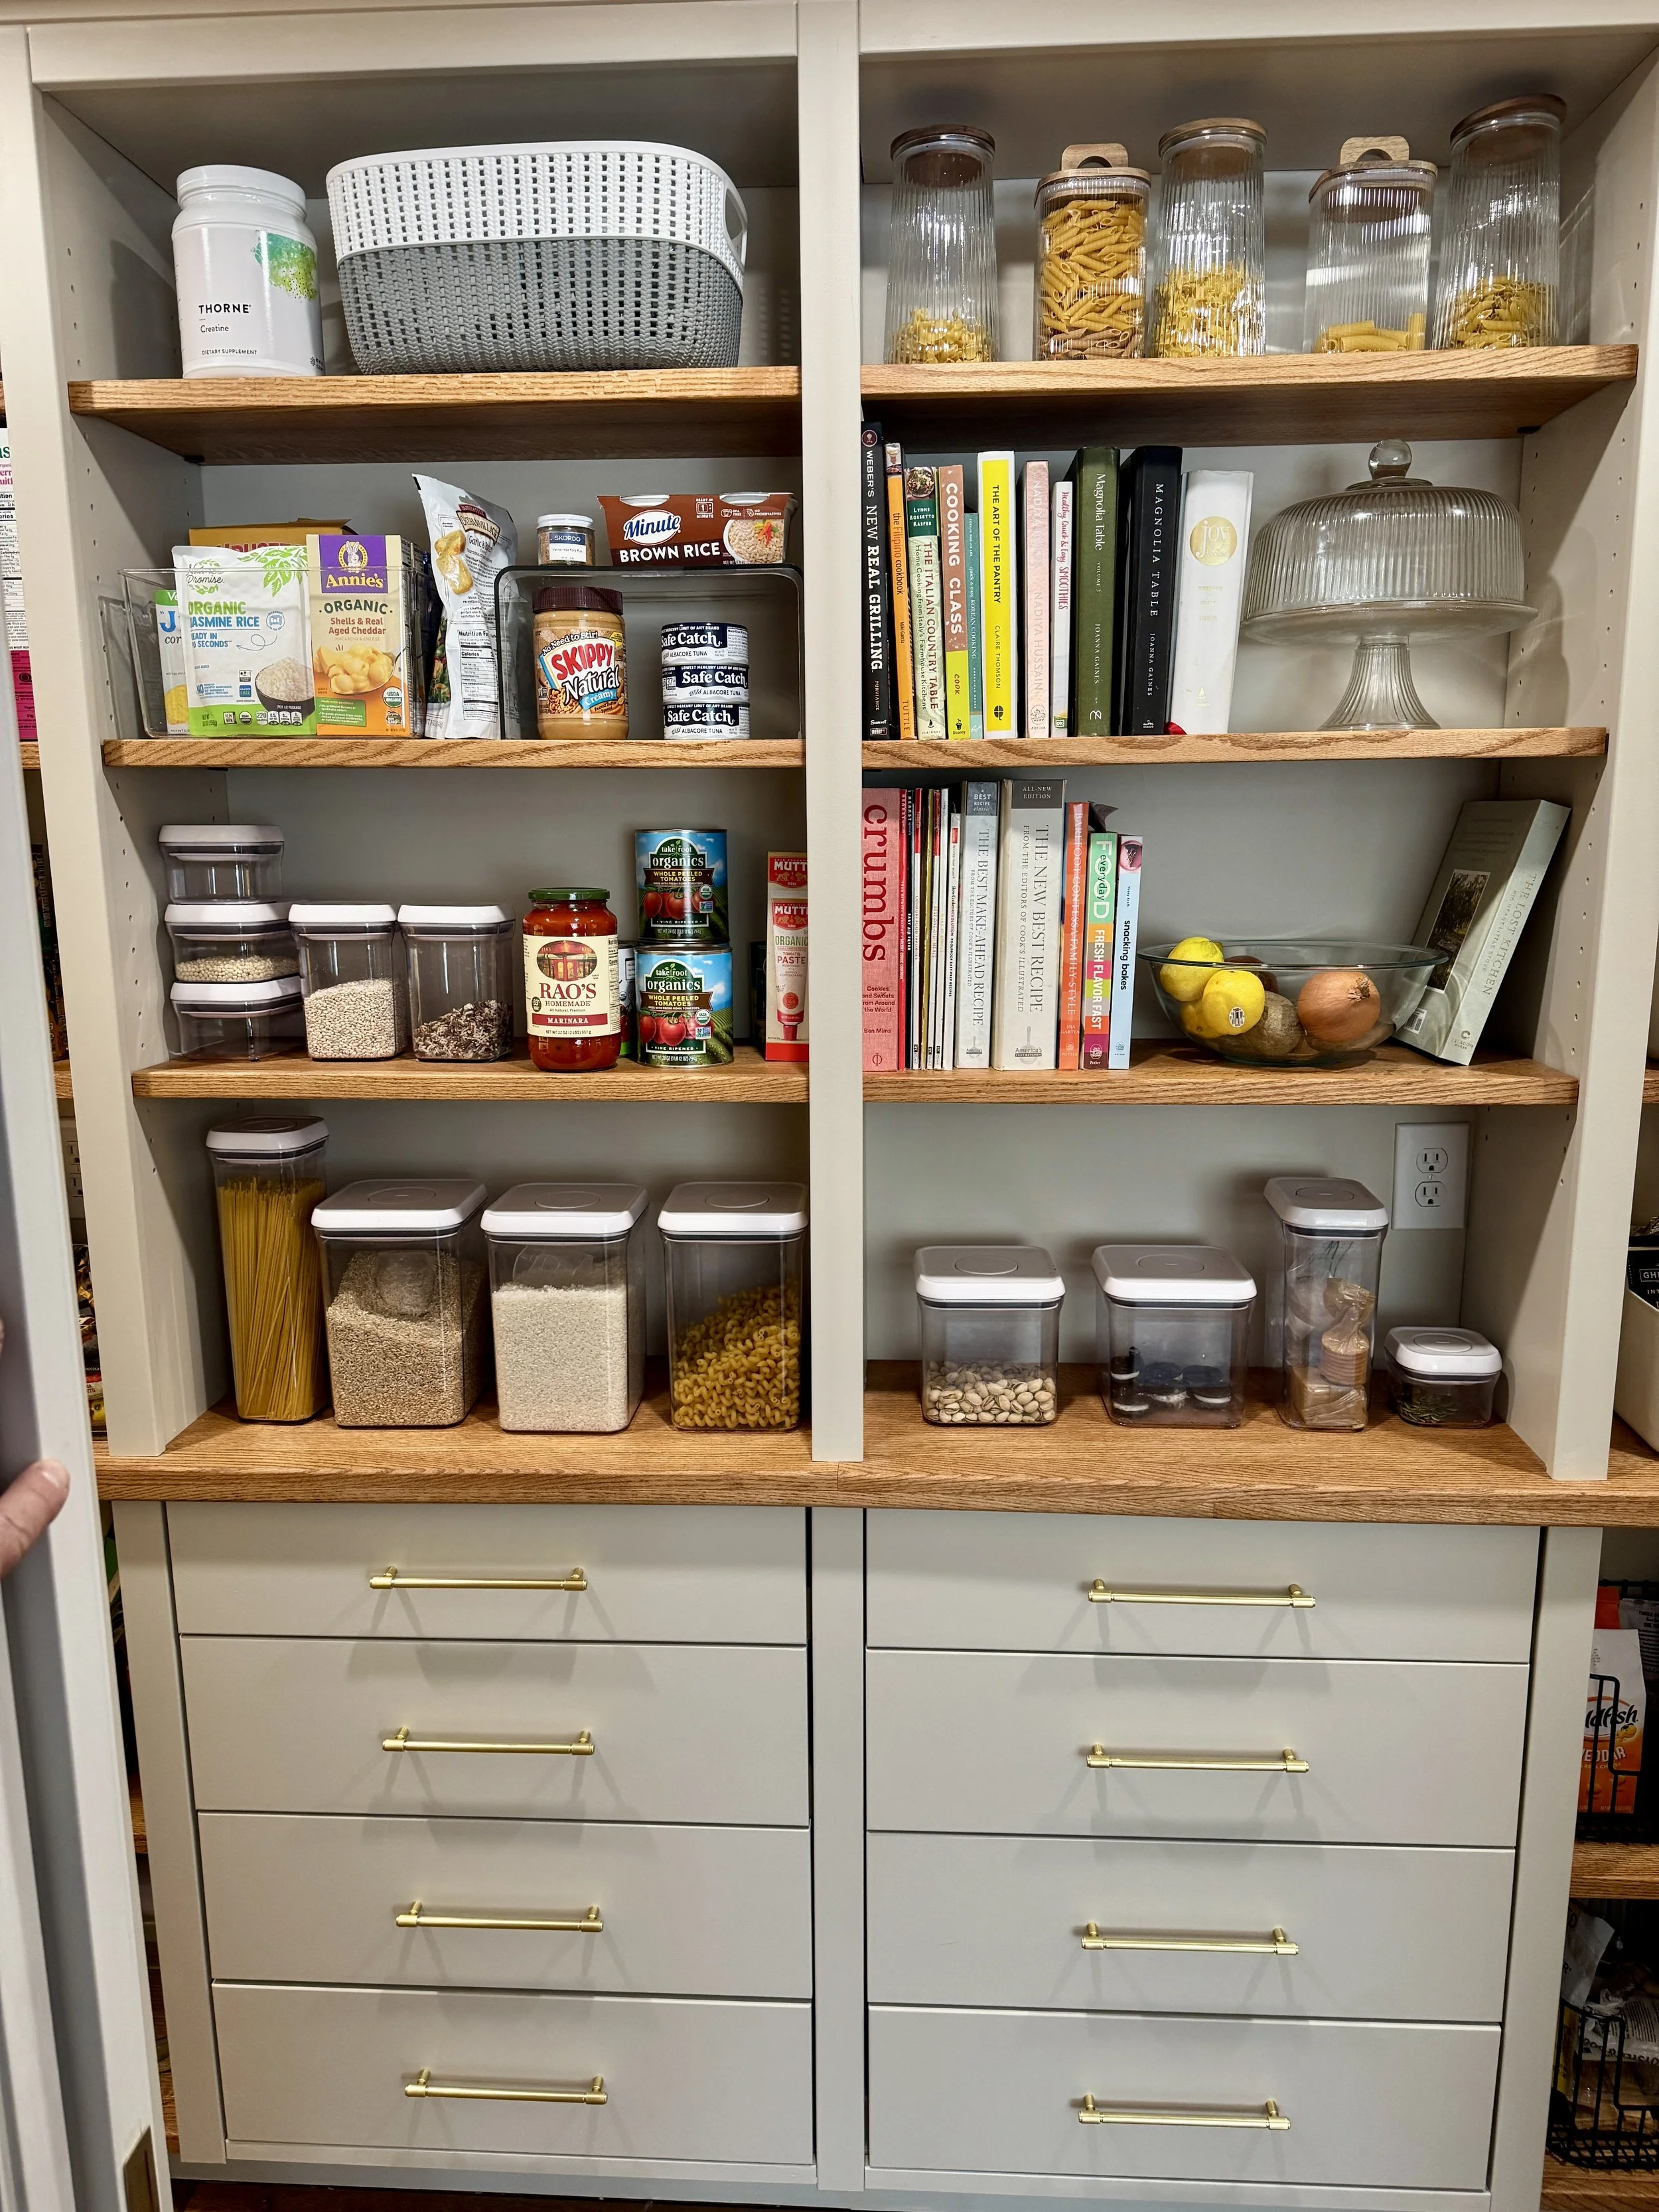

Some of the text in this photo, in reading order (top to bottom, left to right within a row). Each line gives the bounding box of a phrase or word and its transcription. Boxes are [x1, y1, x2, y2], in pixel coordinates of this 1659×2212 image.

[198, 303, 250, 315] THORNE
[200, 324, 229, 333] Creatine
[1093, 473, 1106, 551] Magnolia Table
[624, 514, 681, 540] Minute
[993, 528, 1000, 542] OF
[1195, 520, 1230, 558] joy
[619, 542, 721, 563] BROWN RICE
[892, 526, 903, 557] Filipino
[1150, 483, 1164, 616] MAGNOLIA TABLE
[866, 450, 883, 670] WEBER'S NEW REAL GRILLING
[946, 482, 963, 634] COOKING CLASS
[1056, 549, 1068, 563] Easy
[325, 573, 384, 588] Annie's
[895, 559, 906, 595] cookbook
[1058, 566, 1069, 610] SMOOTHIES
[188, 601, 246, 615] ORGANIC
[324, 599, 388, 615] ORGANIC
[236, 617, 259, 627] RICE
[328, 627, 350, 635] Aged
[924, 542, 938, 709] THE ITALIAN COUNTRY TABLE
[542, 646, 551, 656] No
[550, 635, 571, 648] Need
[581, 631, 598, 640] Stir!
[662, 633, 676, 647] Safe
[678, 631, 721, 647] Catch
[1034, 592, 1043, 691] NADIYA HUSSAIN
[551, 643, 613, 680] SKIPPY
[562, 664, 620, 705] Natural
[682, 671, 713, 684] Safe
[714, 670, 748, 688] Catch
[585, 690, 614, 705] Creamy
[667, 709, 735, 725] Safe Catch
[652, 855, 704, 869] organics
[774, 861, 808, 871] MUTT
[863, 804, 895, 962] crumbs
[1093, 840, 1112, 919] FOOD
[1097, 855, 1108, 901] everyday
[1520, 873, 1537, 899] THE
[973, 828, 989, 1025] THE BEST MAKE-AHEAD RECIPE
[1020, 911, 1027, 922] OF
[1030, 825, 1049, 1012] THE NEW BEST RECIPE
[1067, 813, 1083, 1015] BAREFOOT CONTESSA FAMILY STYLE
[1508, 903, 1525, 935] LOST
[775, 935, 808, 946] ORGANIC
[1119, 920, 1131, 990] snacking bakes
[1482, 937, 1511, 995] KITCHEN
[539, 982, 597, 999] RAO'S
[647, 980, 701, 993] organics
[1091, 929, 1105, 1029] FRESH FLAVOR FAST
